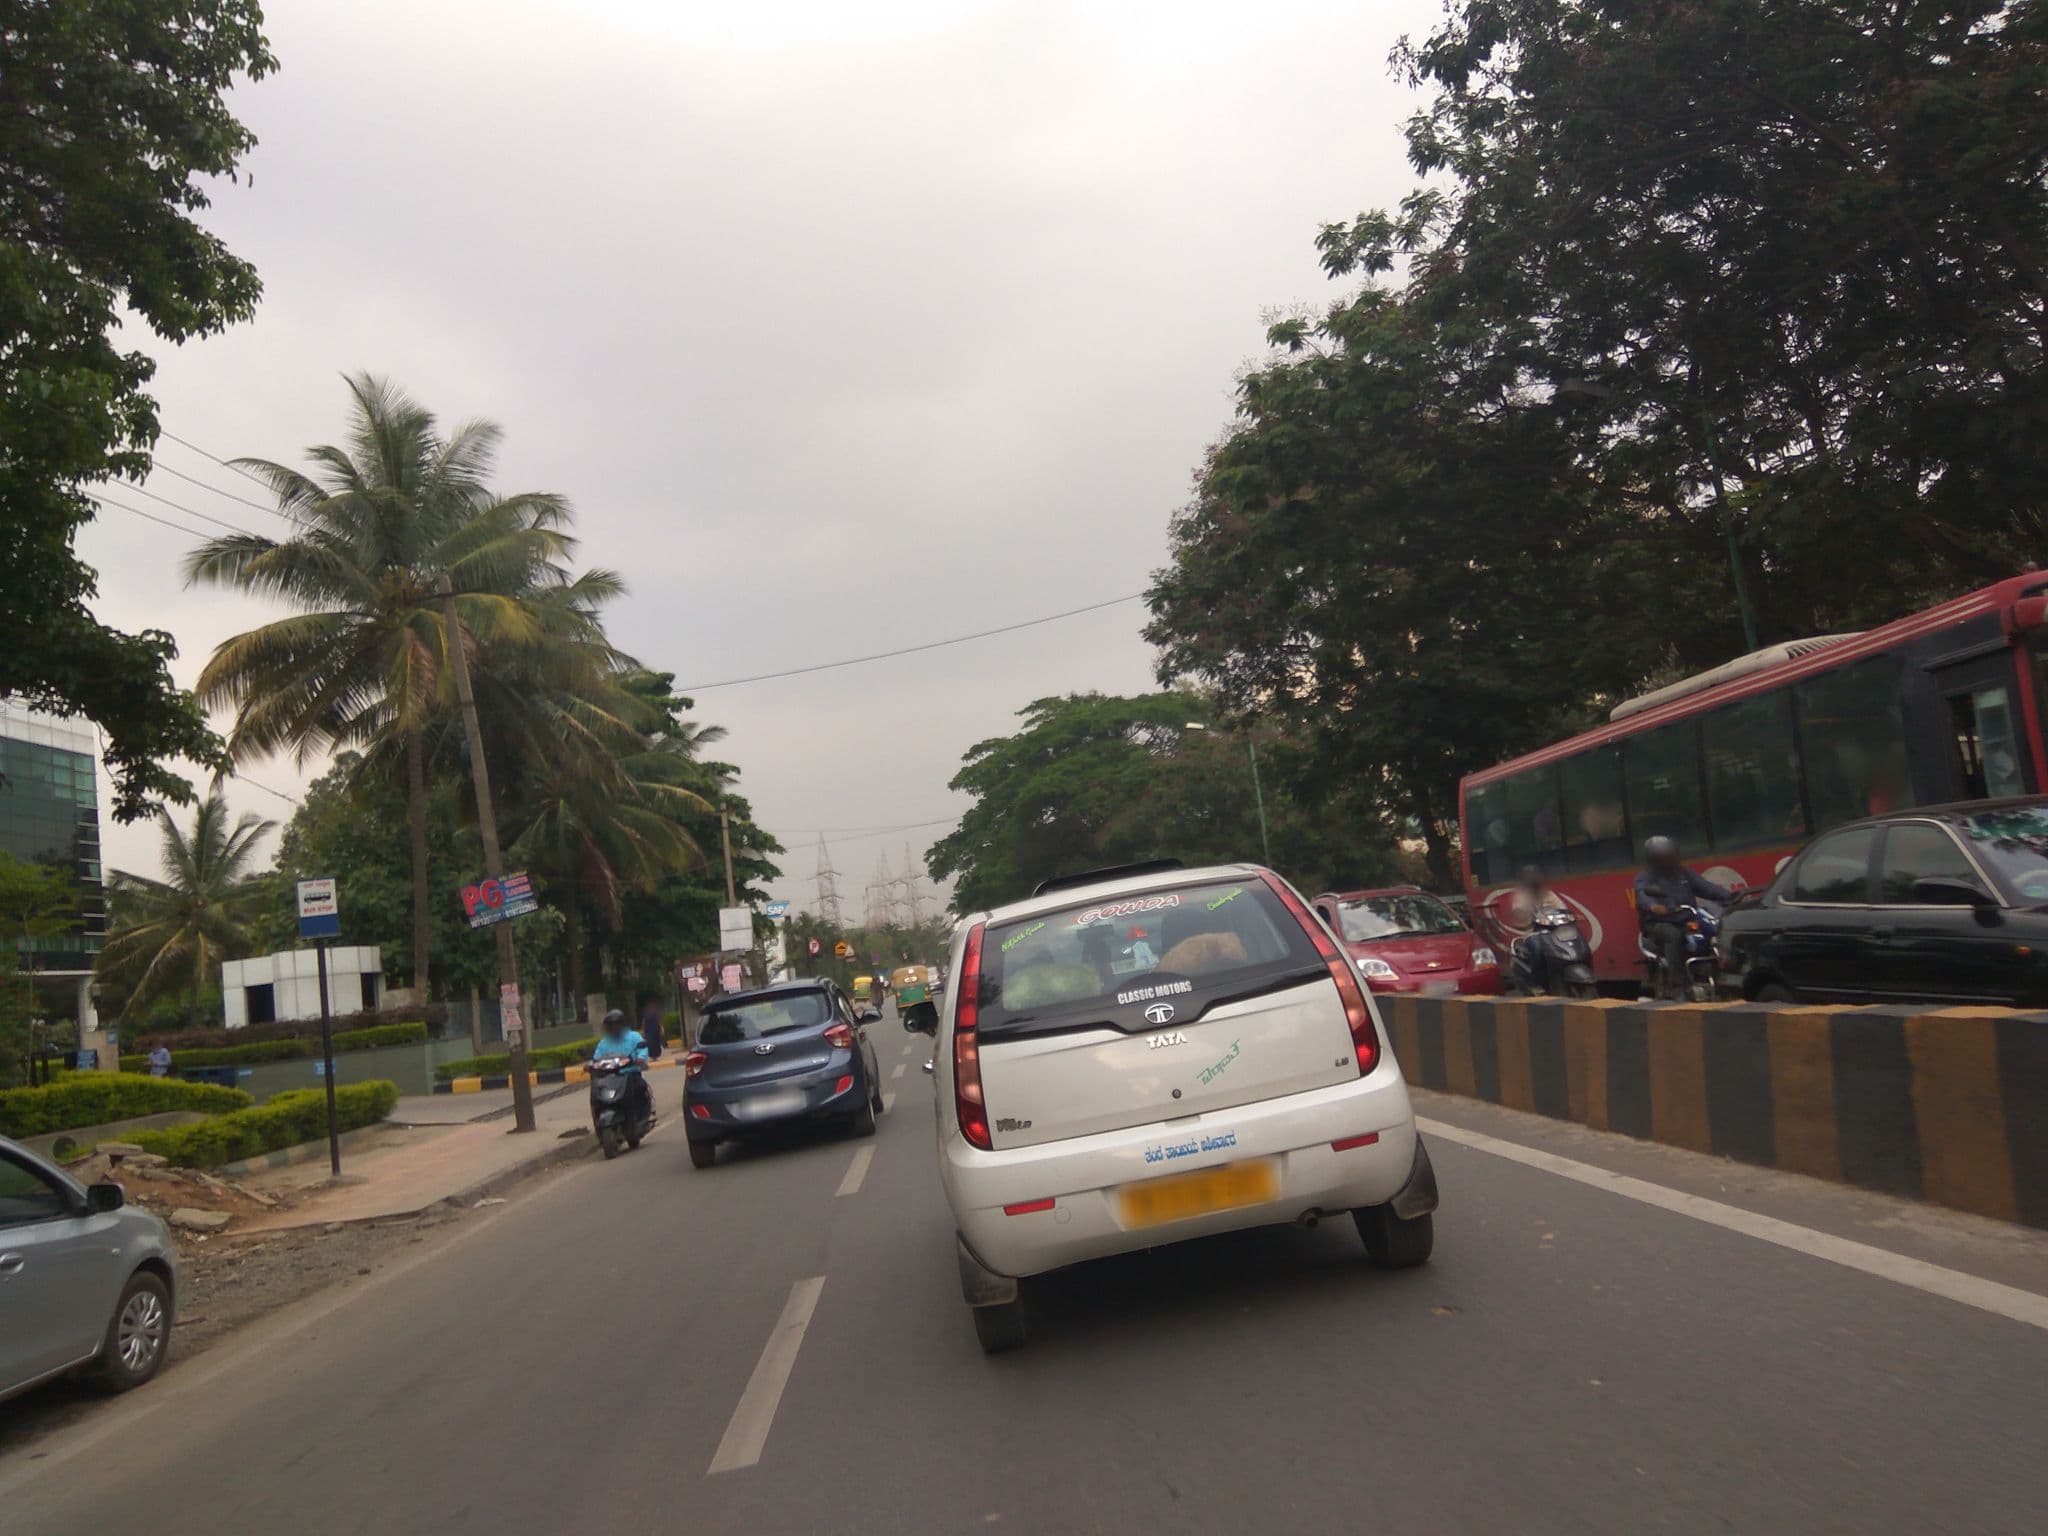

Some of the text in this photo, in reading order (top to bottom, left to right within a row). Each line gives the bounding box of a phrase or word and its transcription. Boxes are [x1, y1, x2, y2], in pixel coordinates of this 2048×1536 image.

[461, 879, 505, 917] PG
[767, 904, 785, 915] SAP
[1077, 894, 1180, 925] GOWDA
[1117, 980, 1193, 1005] CLASSIC MOTORS
[1146, 1032, 1188, 1049] TATA
